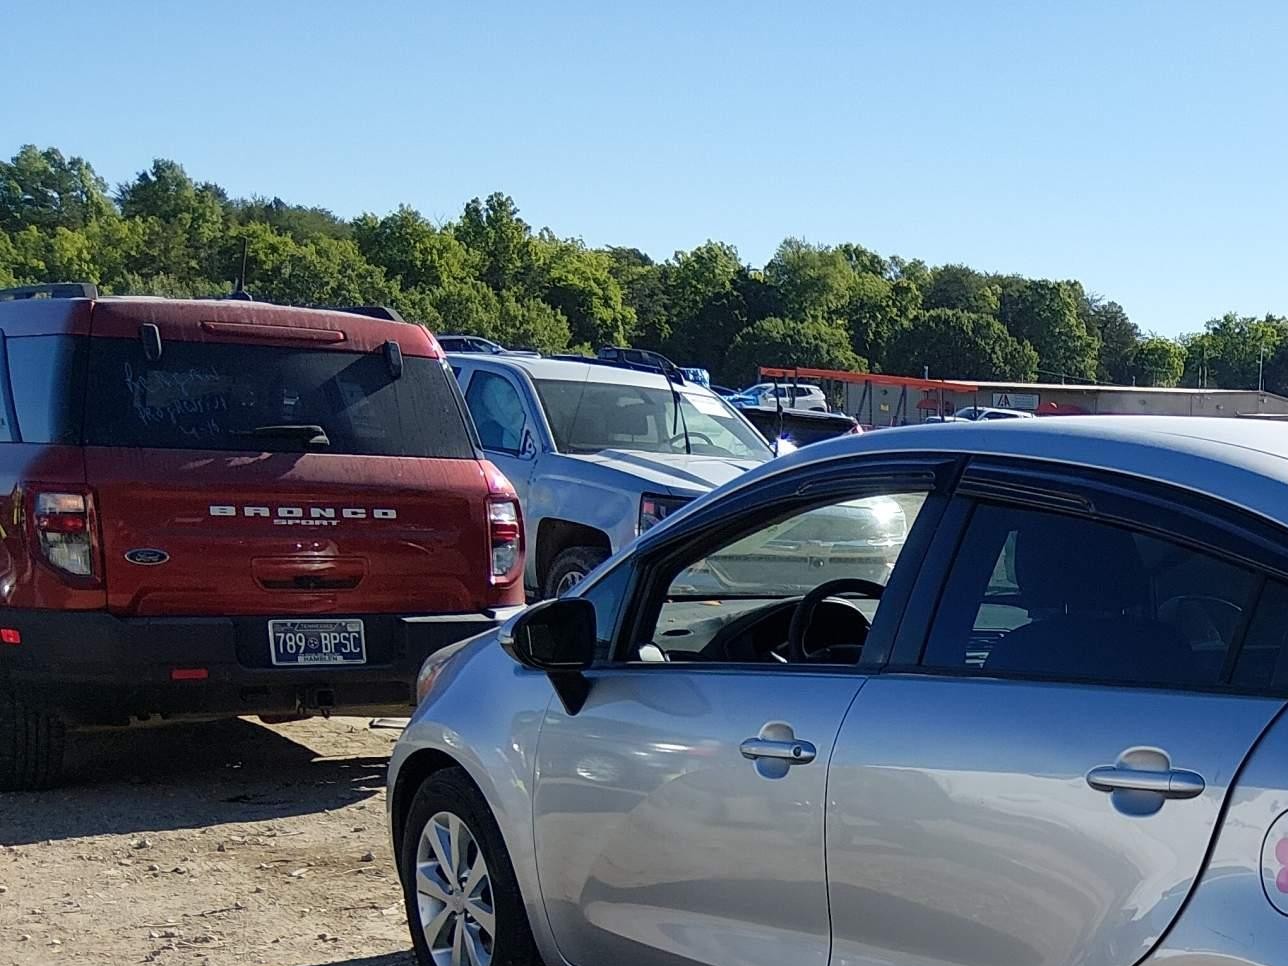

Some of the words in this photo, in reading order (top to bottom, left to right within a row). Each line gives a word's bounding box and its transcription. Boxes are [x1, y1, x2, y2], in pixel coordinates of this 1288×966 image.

[209, 505, 397, 519] BRONCO
[275, 632, 305, 654] 789
[320, 632, 360, 653] BPSC
